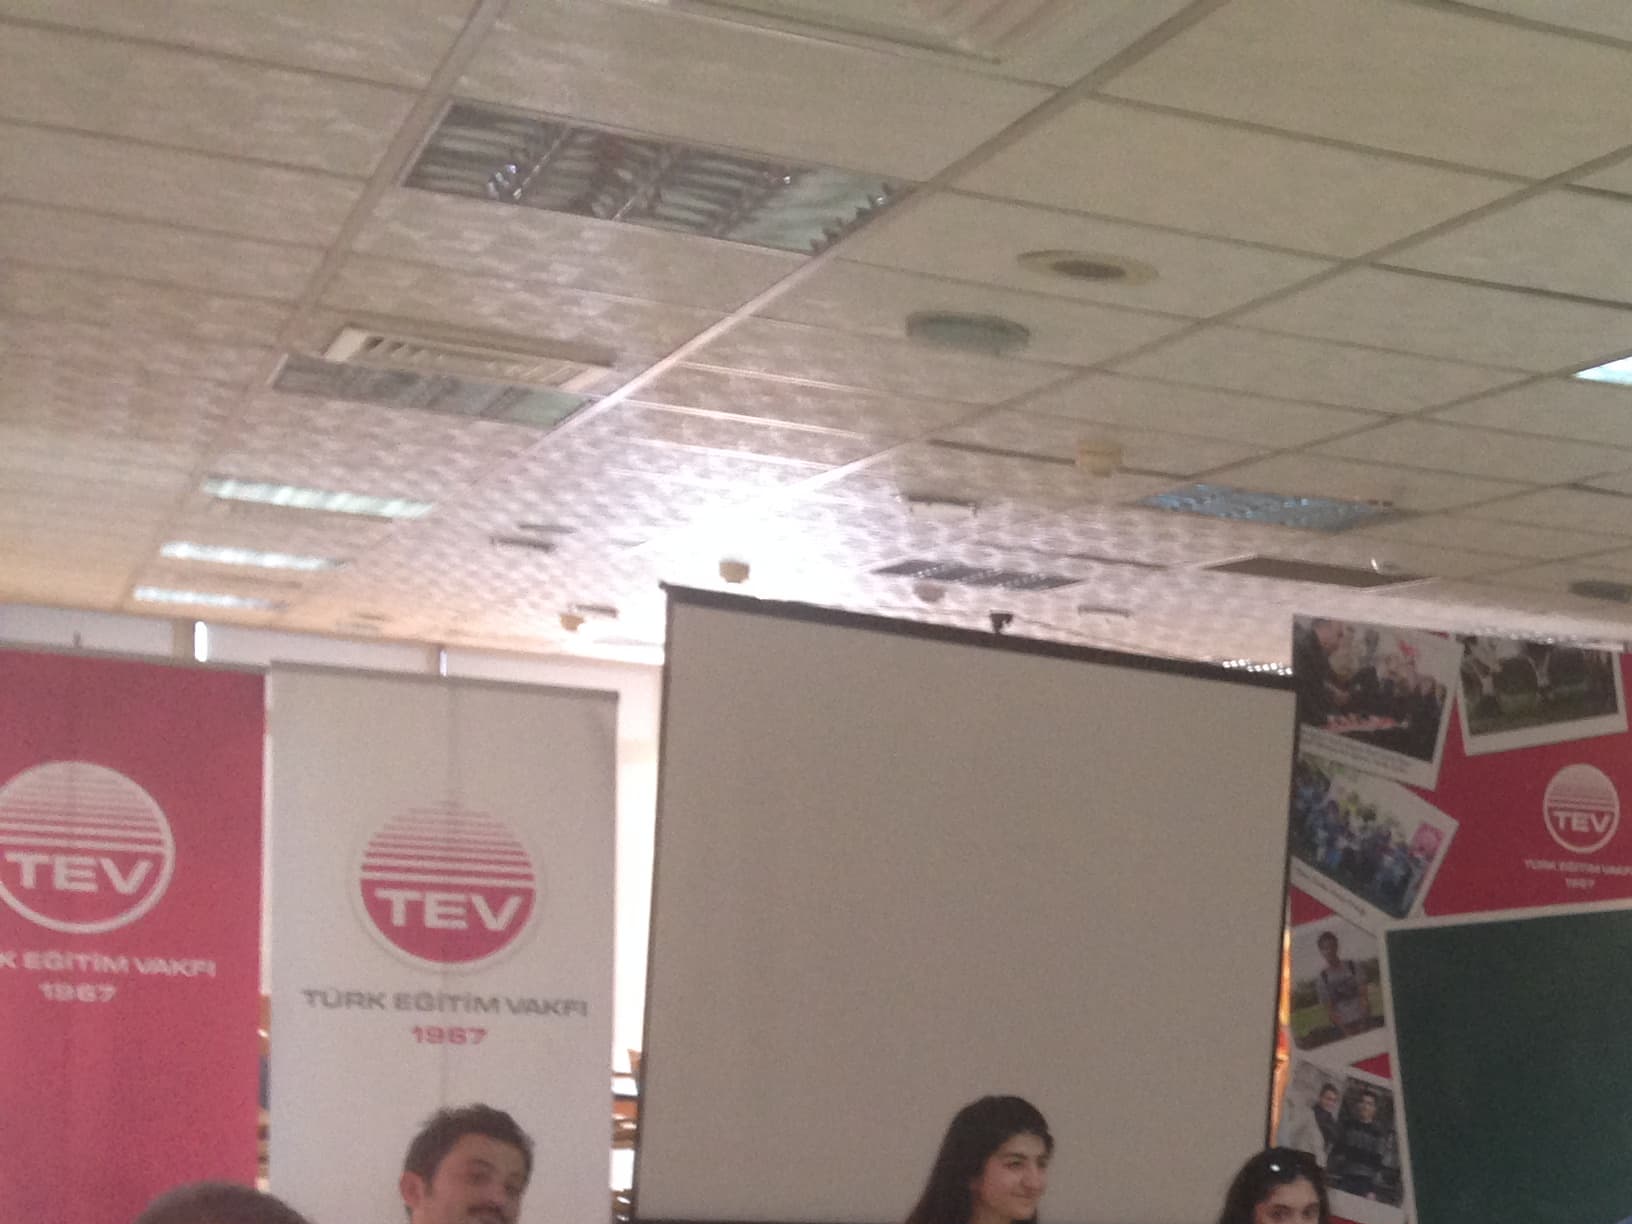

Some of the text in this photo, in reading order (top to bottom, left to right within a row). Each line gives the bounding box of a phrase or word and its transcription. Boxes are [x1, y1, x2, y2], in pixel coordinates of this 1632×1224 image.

[1552, 810, 1611, 833] TEV
[4, 851, 154, 895] TEV
[373, 886, 523, 932] TEV
[301, 987, 385, 1011] TÜRK
[502, 995, 588, 1018] VAKFI
[411, 1024, 488, 1045] 1967
